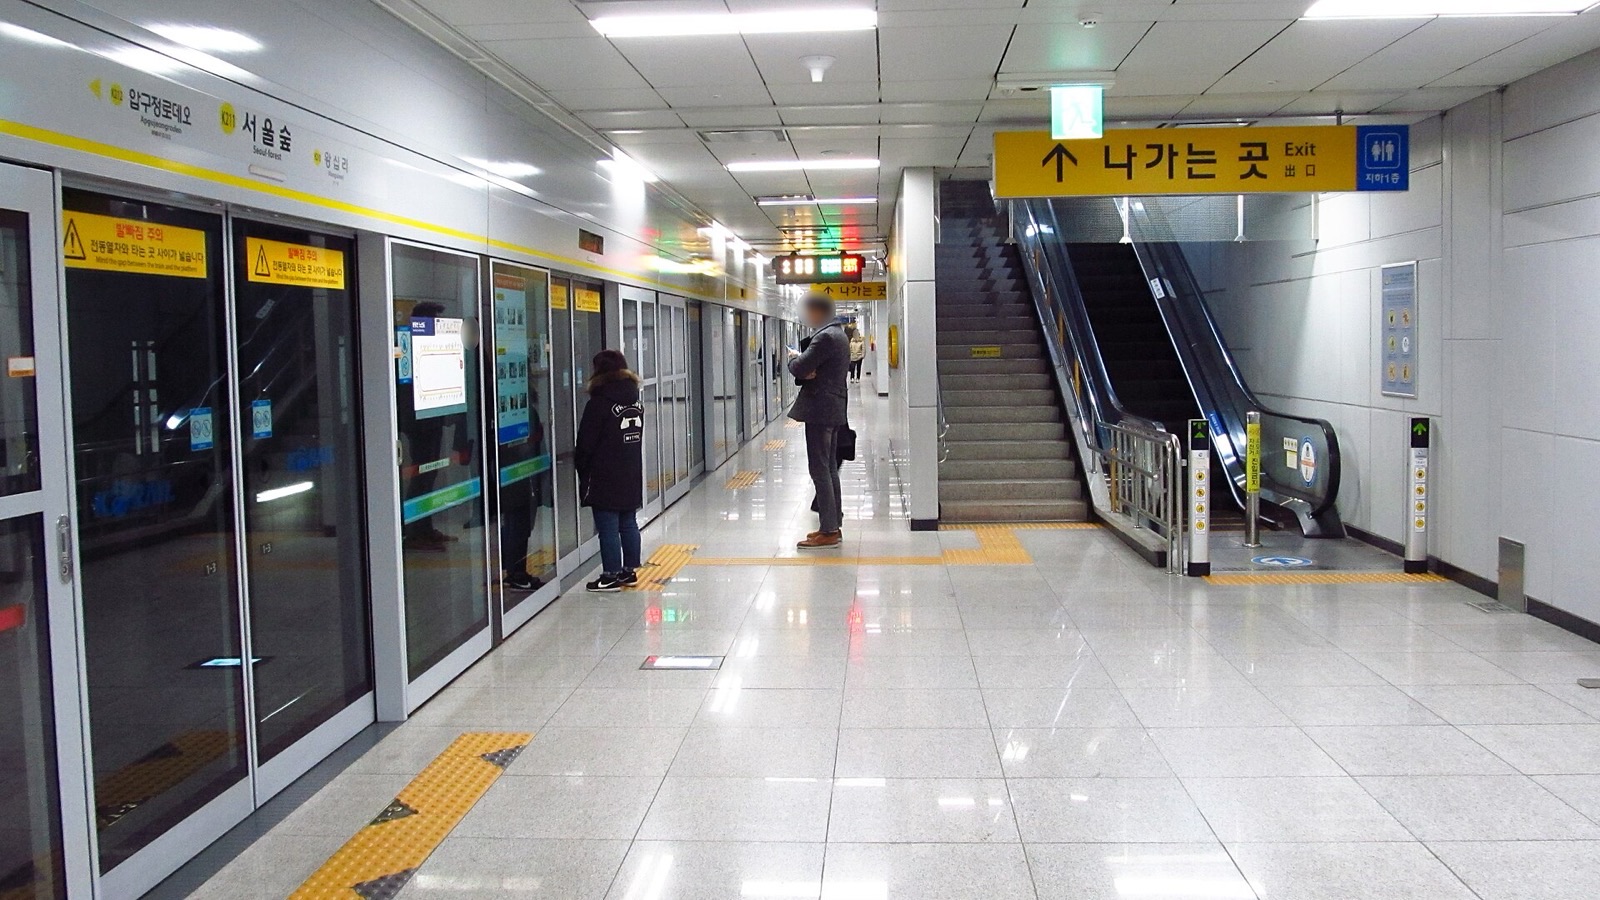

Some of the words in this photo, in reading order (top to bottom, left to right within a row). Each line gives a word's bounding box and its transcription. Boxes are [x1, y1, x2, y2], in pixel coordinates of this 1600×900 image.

[129, 88, 192, 126] 압구정로데오
[242, 112, 291, 152] 서울숲
[1285, 142, 1316, 156] Exit
[324, 151, 348, 173] 왕십리
[1104, 143, 1217, 180] 나가는
[1238, 142, 1269, 180] 곳
[1285, 164, 1316, 177] 出口
[1365, 173, 1400, 184] 지하1층
[116, 223, 144, 241] 발빠짐
[147, 227, 164, 242] 주의
[90, 239, 129, 255] 전동열차와
[131, 244, 146, 258] 타는
[157, 248, 178, 261] 사이가
[178, 251, 204, 264] 넓습니다
[840, 285, 872, 297] 나가는
[877, 285, 886, 297] 곳
[206, 562, 217, 574] 1-3
